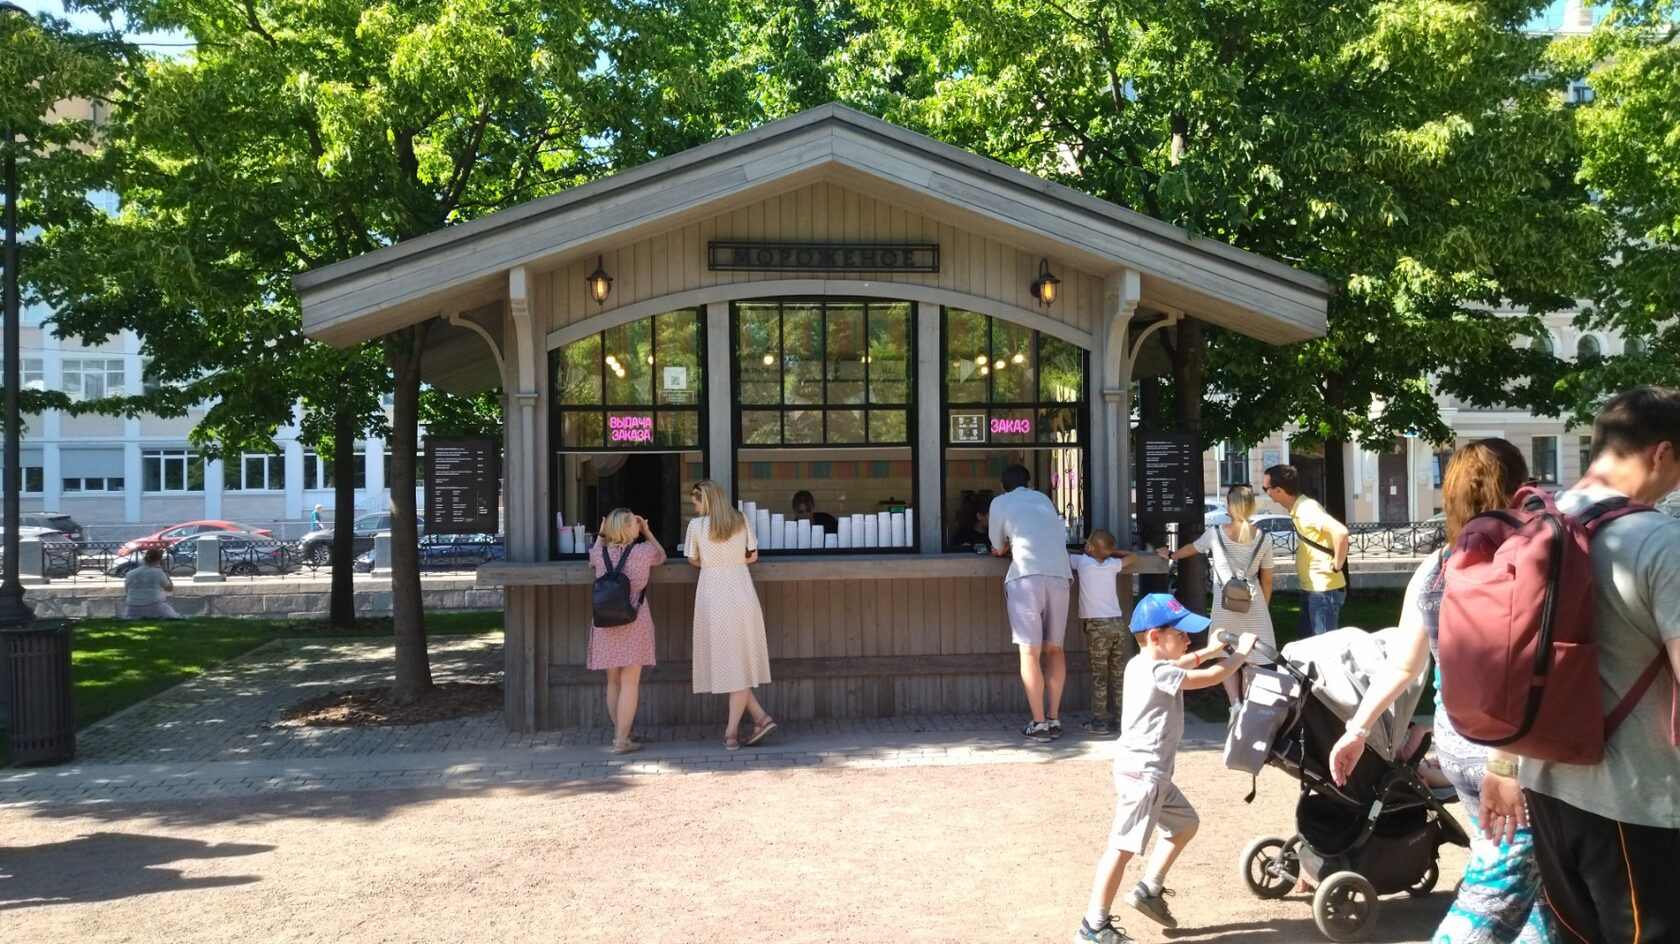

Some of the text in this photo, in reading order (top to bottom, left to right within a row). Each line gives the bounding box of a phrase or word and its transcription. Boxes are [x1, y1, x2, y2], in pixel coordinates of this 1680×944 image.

[733, 249, 915, 267] МОРОЖЕНОЕ
[609, 416, 652, 429] ВЫДАЧА
[990, 419, 1030, 433] ЗАКАЗ
[611, 429, 651, 441] ЗАКАЗА
